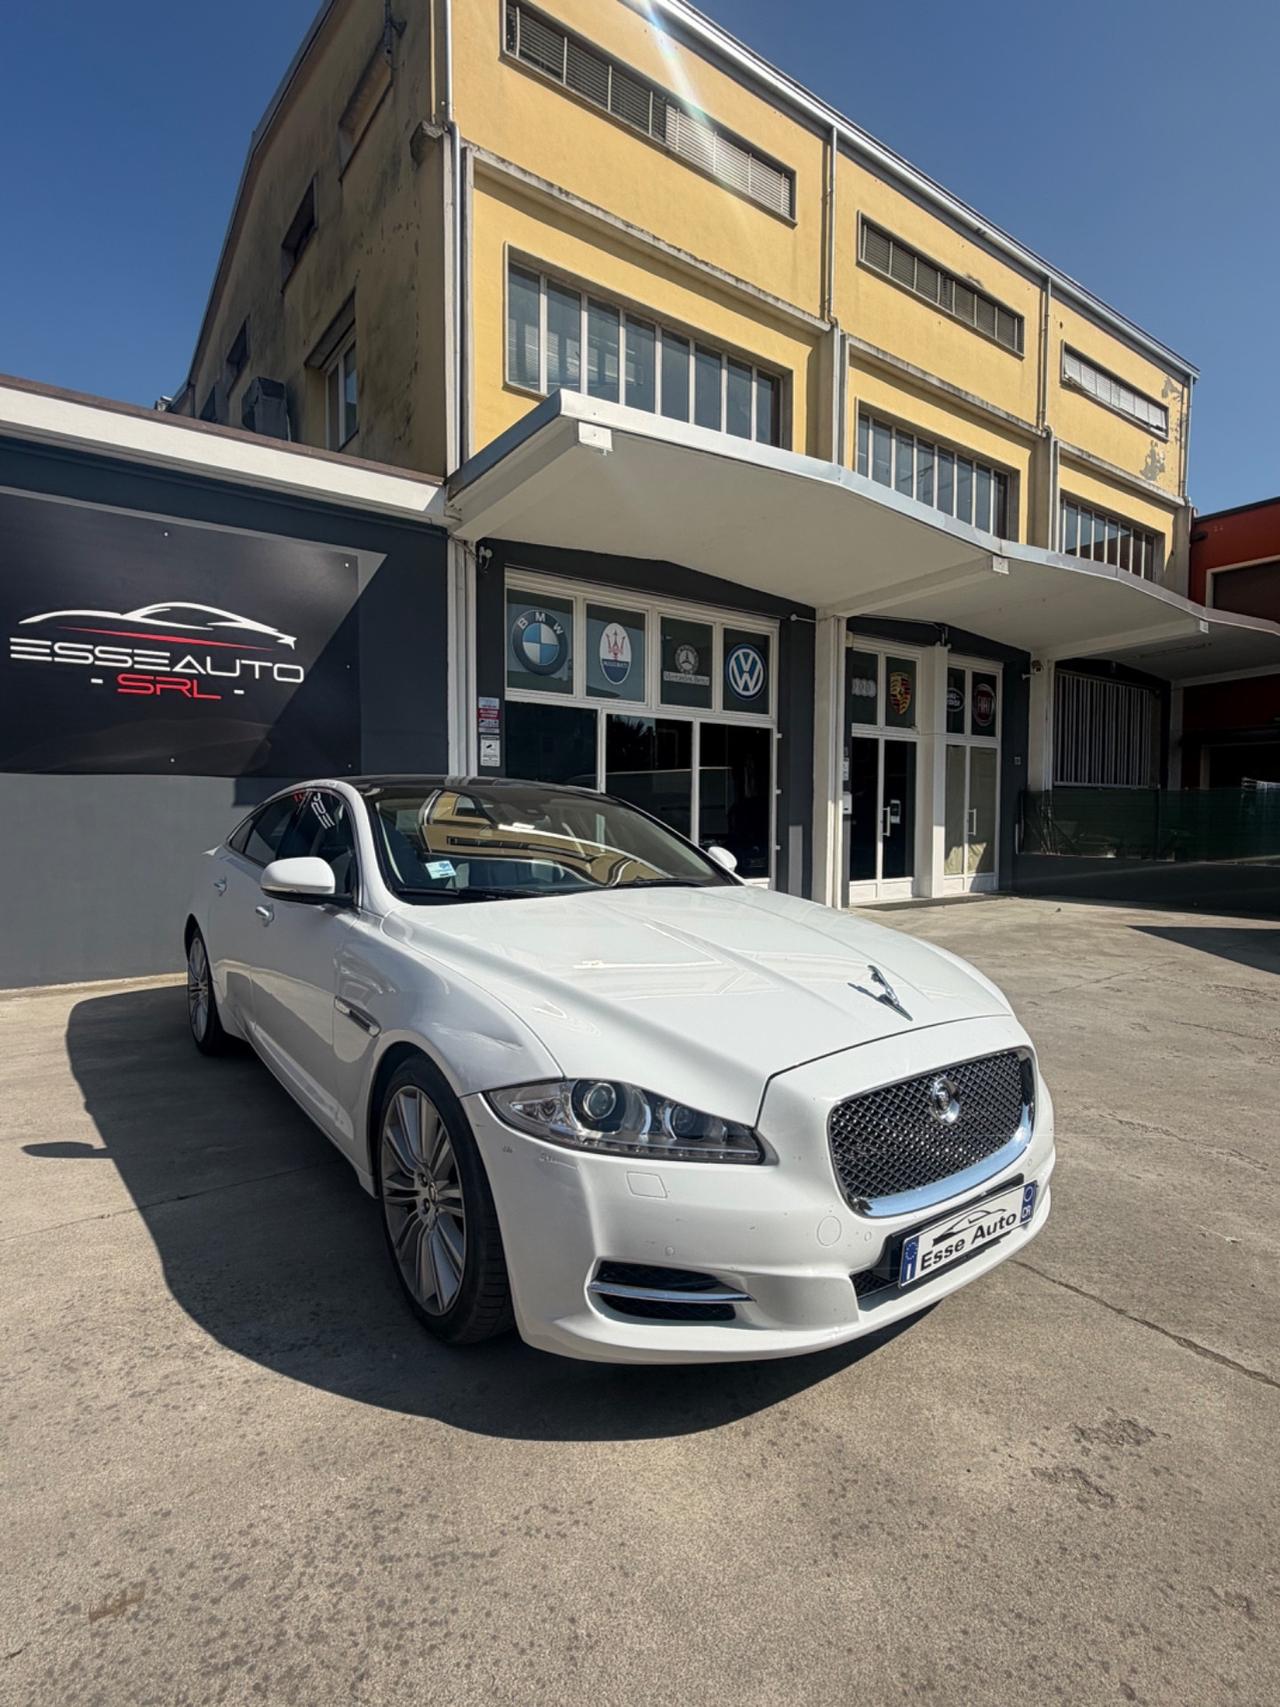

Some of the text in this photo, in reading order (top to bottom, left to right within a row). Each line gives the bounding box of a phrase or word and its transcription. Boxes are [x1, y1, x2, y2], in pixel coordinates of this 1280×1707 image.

[518, 611, 564, 635] BMW
[117, 673, 222, 700] SRL
[920, 1213, 1017, 1272] Esse Auto
